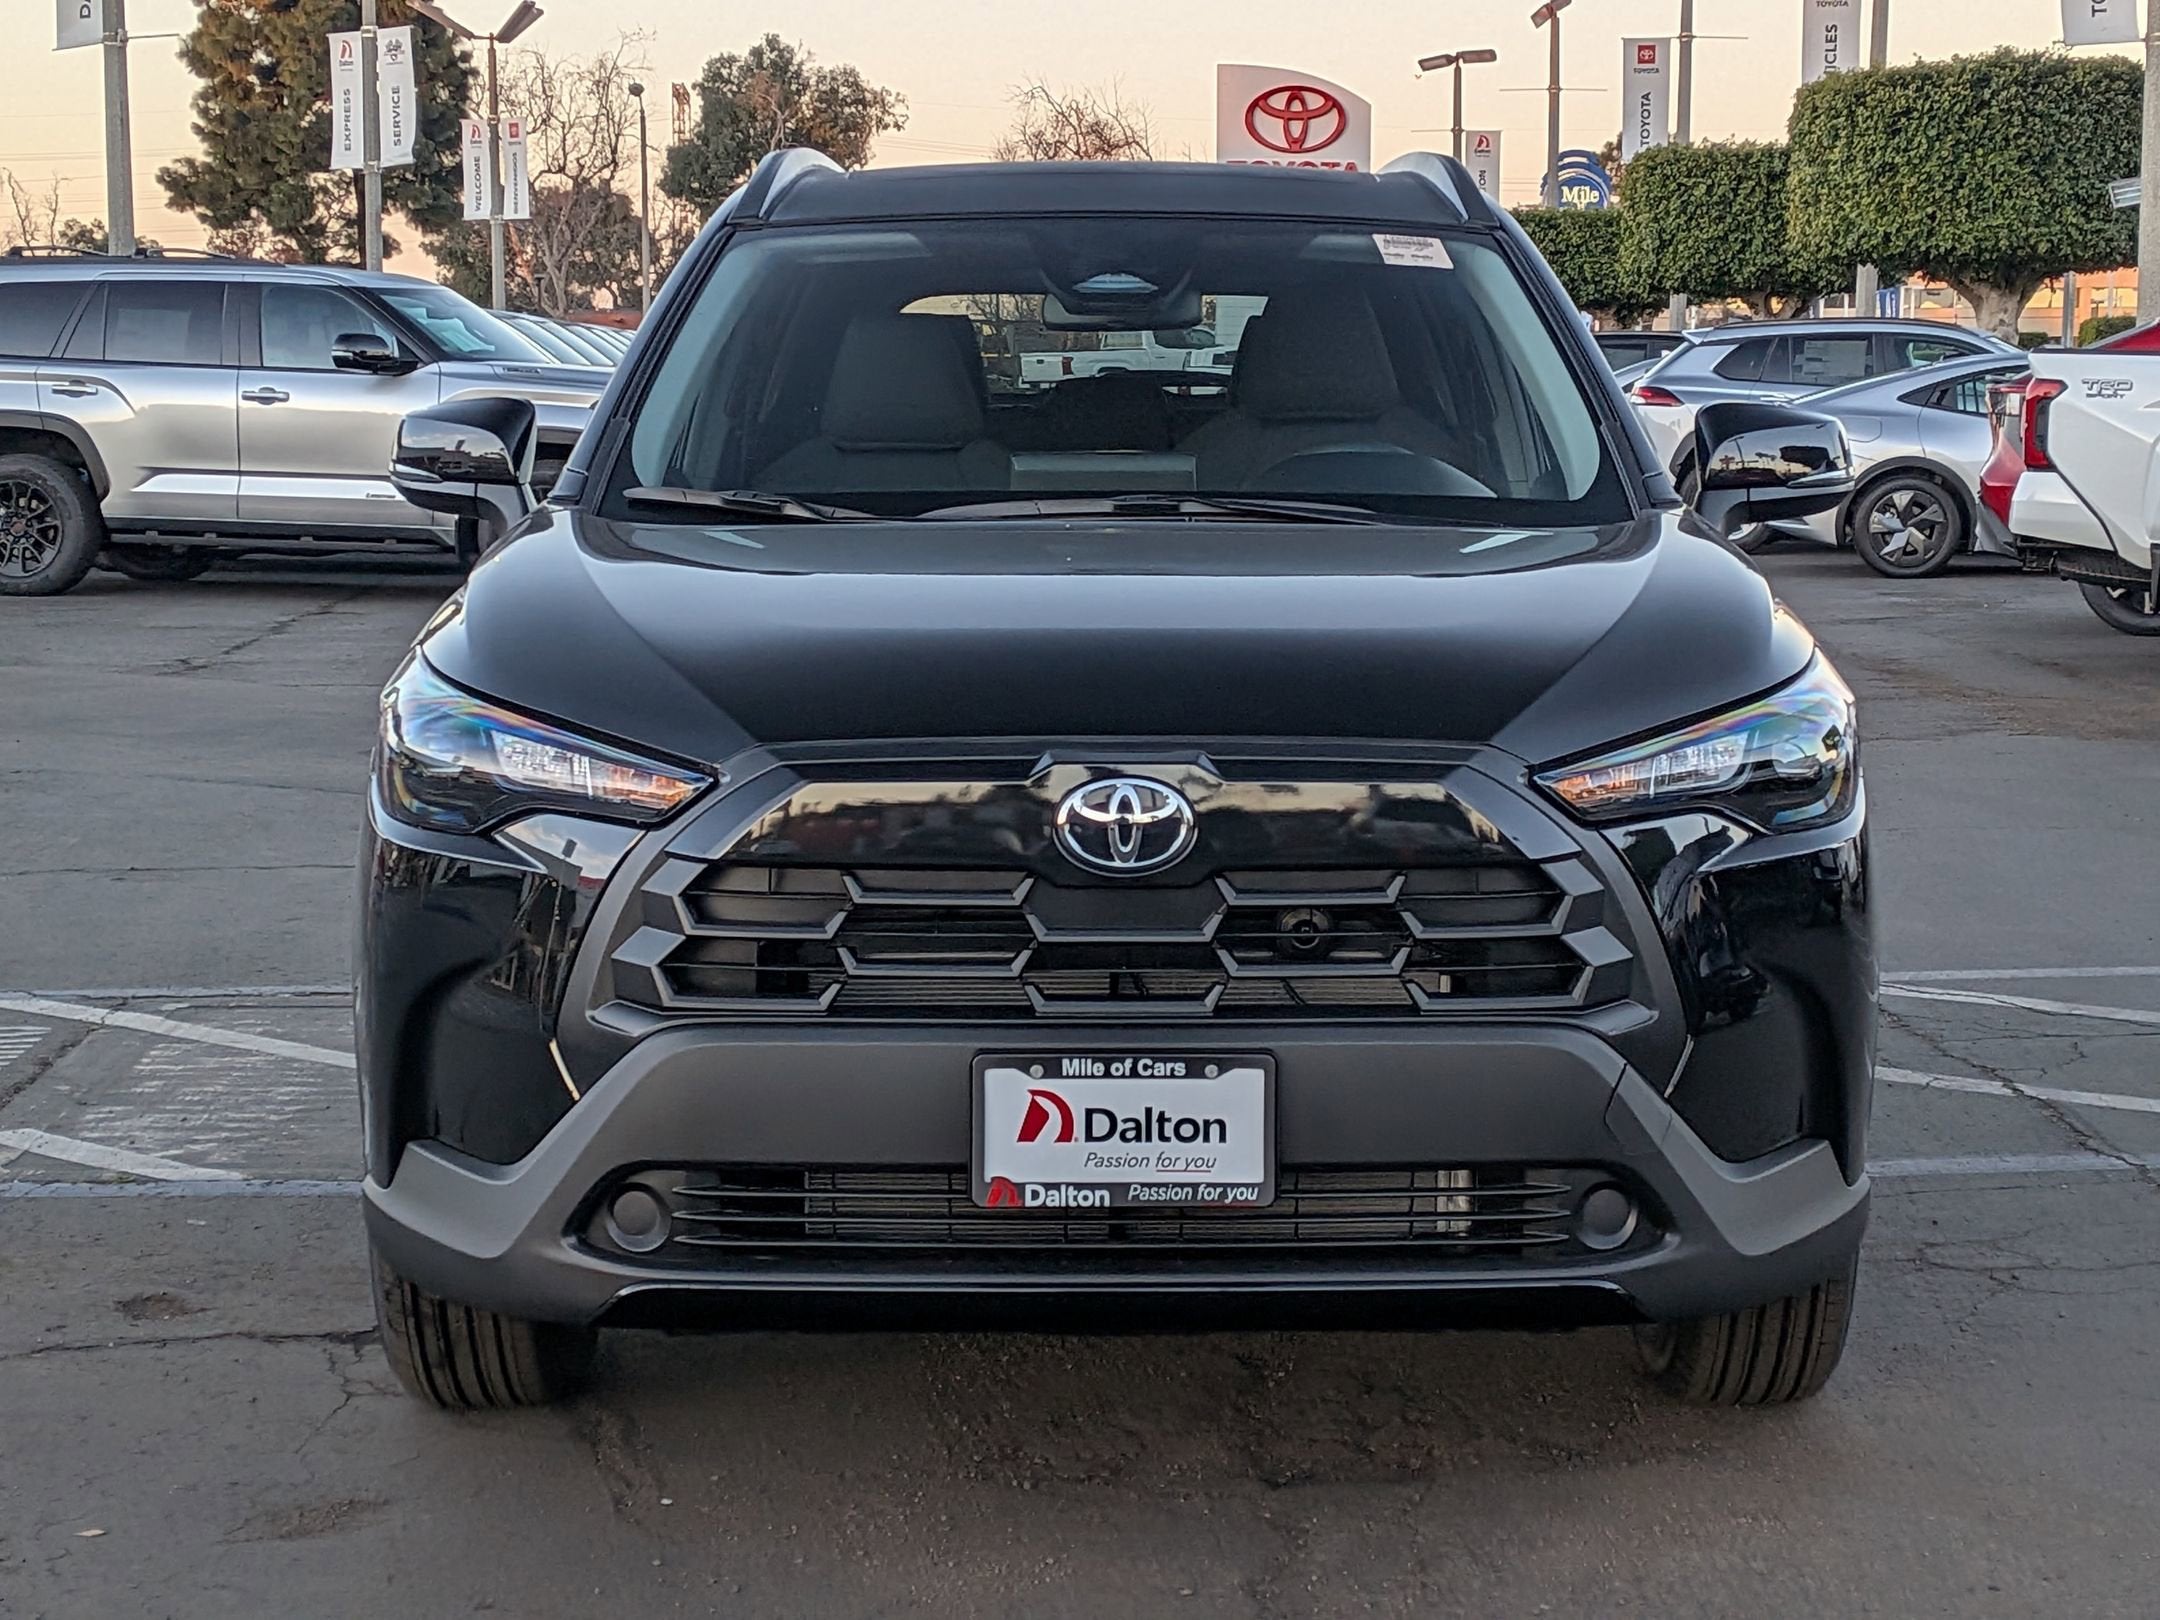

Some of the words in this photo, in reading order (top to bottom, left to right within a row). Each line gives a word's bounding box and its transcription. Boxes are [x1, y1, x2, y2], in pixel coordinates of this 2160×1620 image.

[80, 0, 91, 18] D
[1816, 0, 1849, 8] TOYOTA
[1824, 24, 1838, 74] ICLES
[343, 88, 352, 152] EXPRESS
[391, 85, 401, 147] SERVICE
[1640, 91, 1652, 148] TOYOTA
[473, 155, 482, 212] WELCOME
[1561, 185, 1600, 204] Mile
[2081, 378, 2134, 393] TRD
[1062, 1058, 1105, 1077] Mile
[1109, 1058, 1133, 1077] of
[1137, 1058, 1187, 1077] Cars
[1084, 1106, 1227, 1144] Dalton
[1084, 1152, 1150, 1169] Passion
[1154, 1151, 1181, 1170] for
[1184, 1156, 1217, 1171] you
[1025, 1184, 1111, 1208] Dalton
[1127, 1184, 1193, 1201] Passion
[1197, 1184, 1225, 1202] for
[1226, 1186, 1259, 1205] you
